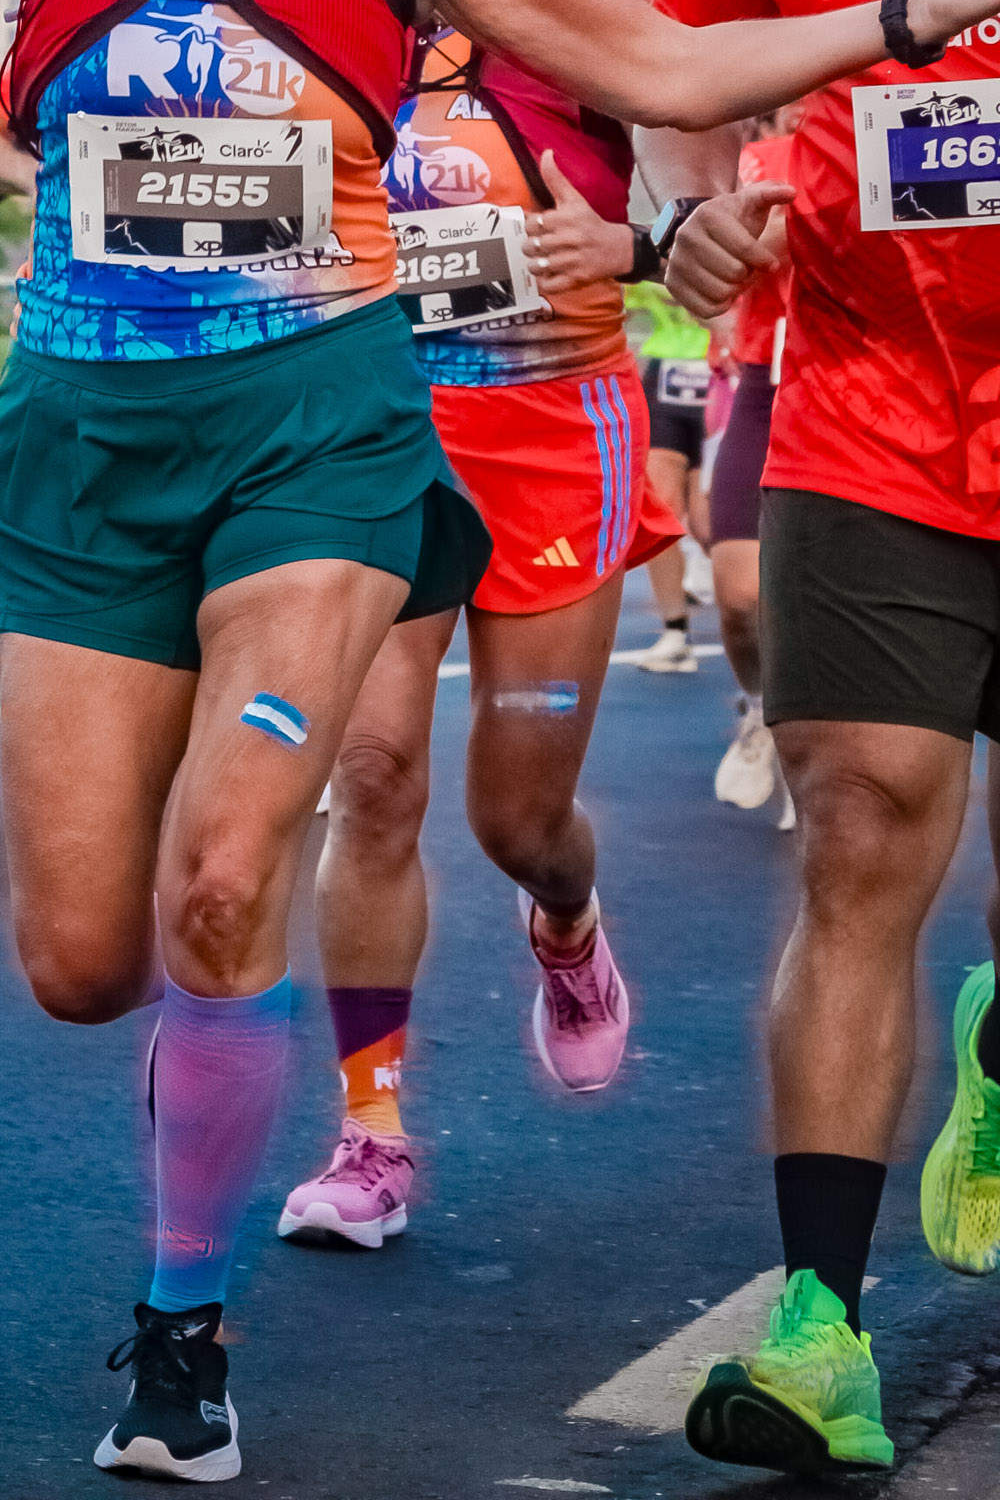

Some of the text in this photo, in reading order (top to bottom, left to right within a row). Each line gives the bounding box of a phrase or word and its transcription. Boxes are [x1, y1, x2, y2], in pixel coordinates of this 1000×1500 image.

[219, 141, 266, 159] Claro
[921, 135, 1000, 169] 166
[137, 172, 270, 208] 21555
[439, 224, 475, 239] Claro
[393, 250, 480, 284] 21621
